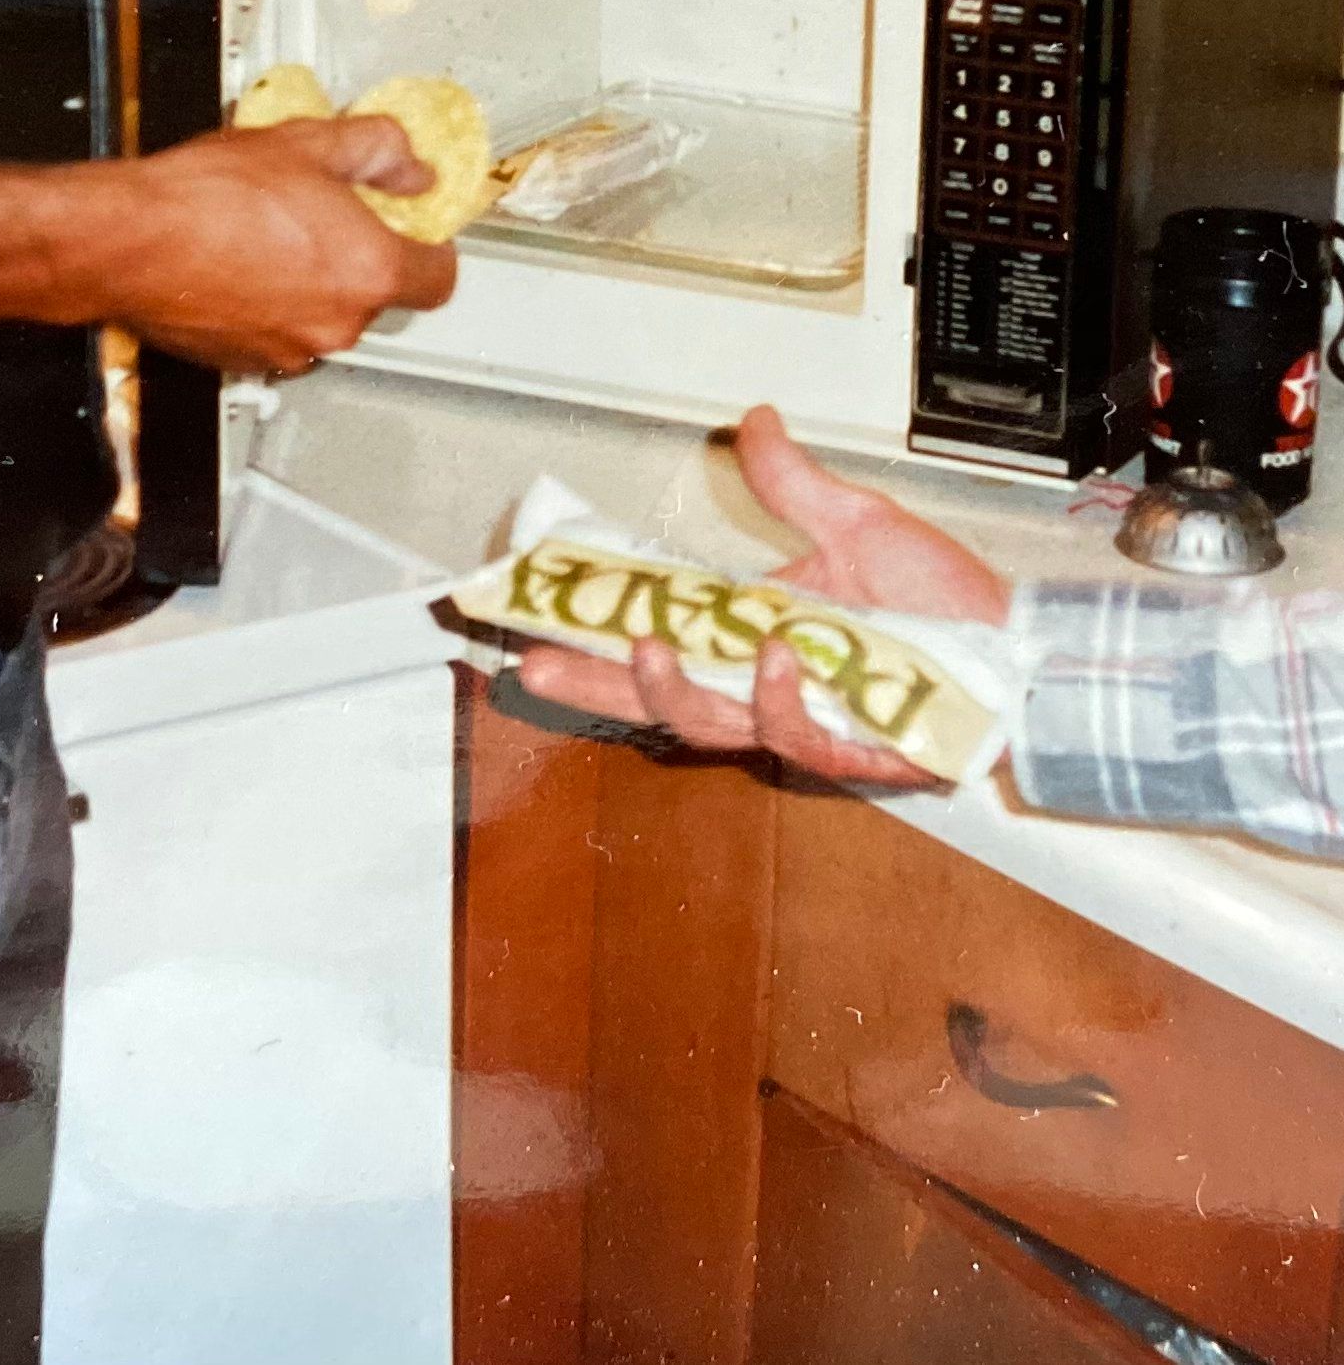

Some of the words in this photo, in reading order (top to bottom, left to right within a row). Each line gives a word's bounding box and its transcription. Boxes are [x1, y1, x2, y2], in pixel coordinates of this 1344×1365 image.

[957, 69, 967, 86] 1
[998, 74, 1012, 93] 2
[1041, 80, 1055, 99] 3
[953, 104, 968, 120] 4
[996, 109, 1011, 127] 5
[954, 137, 967, 154] 7
[994, 143, 1009, 162] 8
[1037, 149, 1053, 167] 9
[992, 178, 1009, 196] 0
